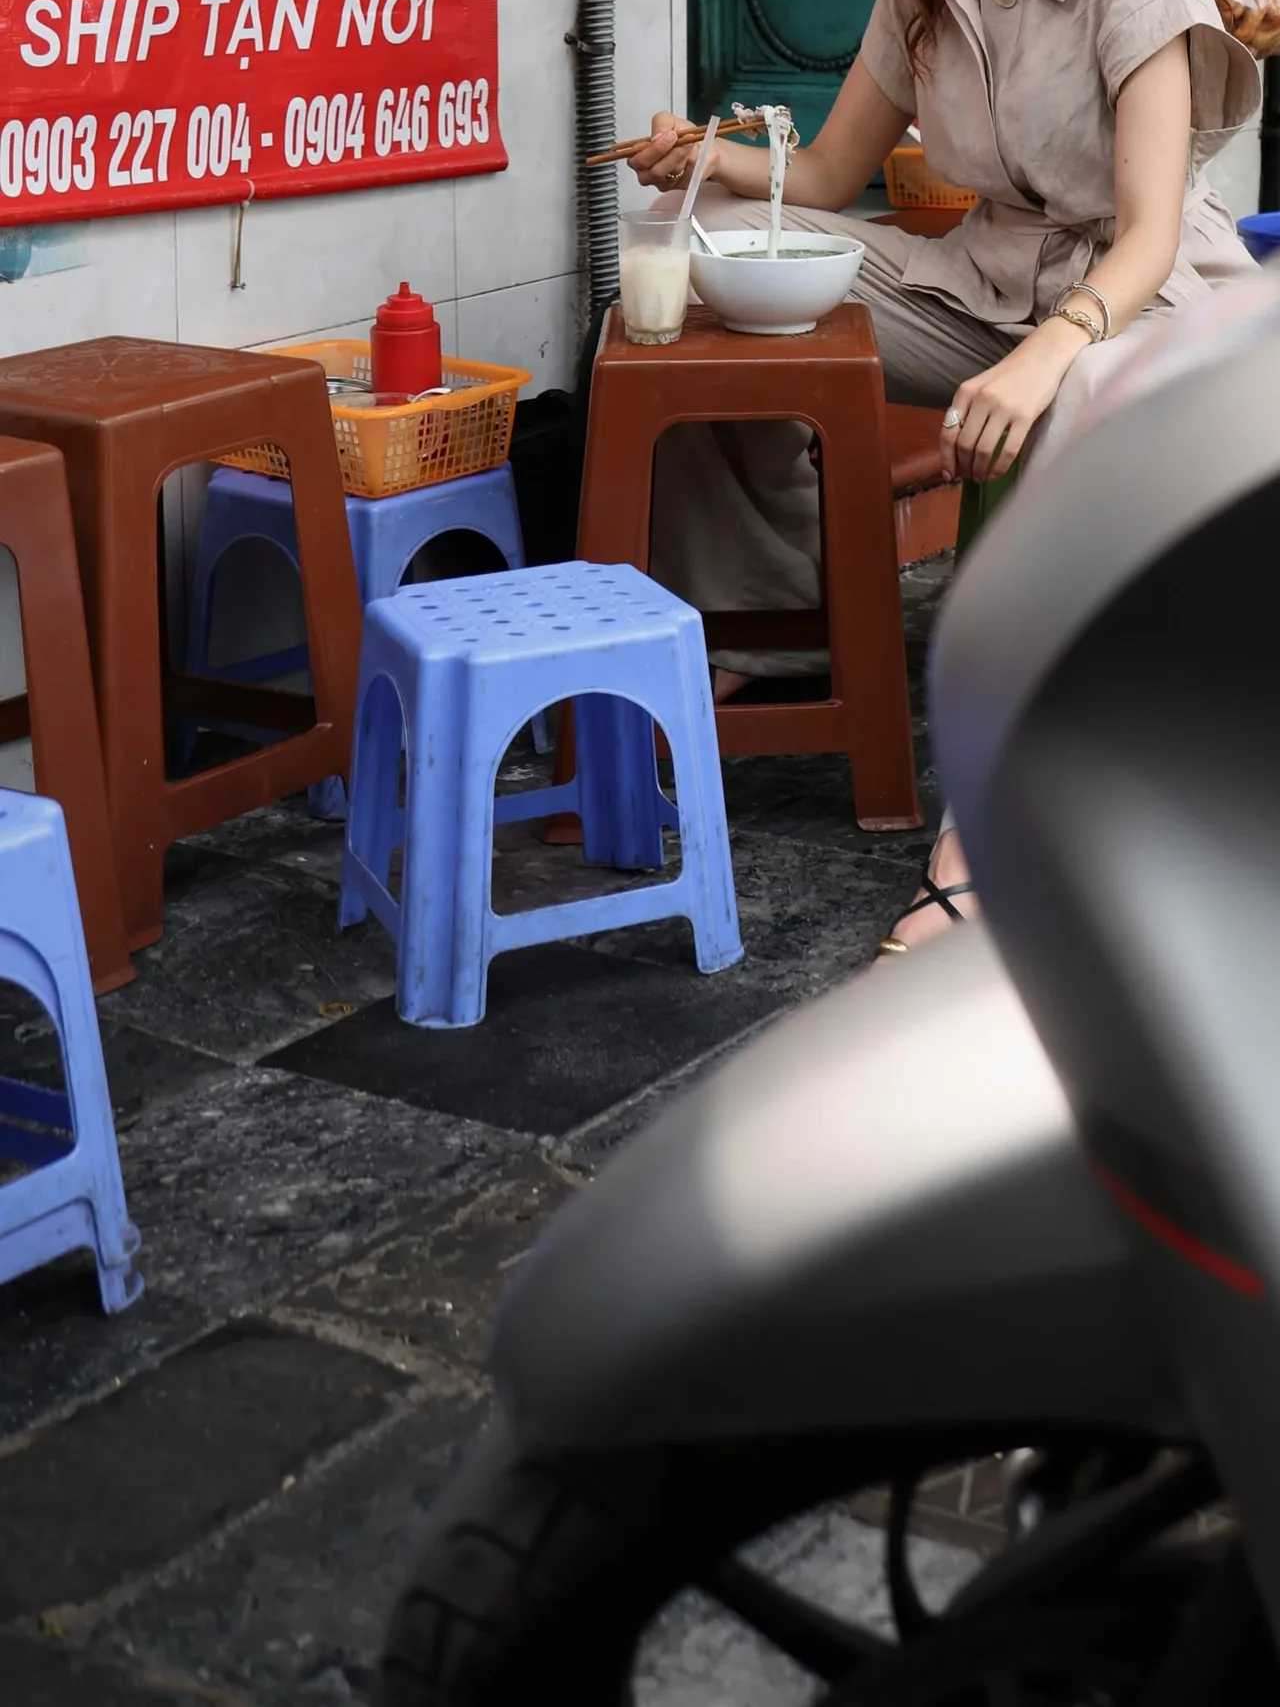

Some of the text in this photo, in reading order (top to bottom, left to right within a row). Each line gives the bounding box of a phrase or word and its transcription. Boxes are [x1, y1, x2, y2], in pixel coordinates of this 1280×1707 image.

[0, 114, 97, 198] 0903
[109, 107, 176, 187] 227
[186, 102, 252, 181] 004
[284, 92, 365, 167] 0904
[375, 87, 430, 161] 646
[437, 78, 489, 146] 693
